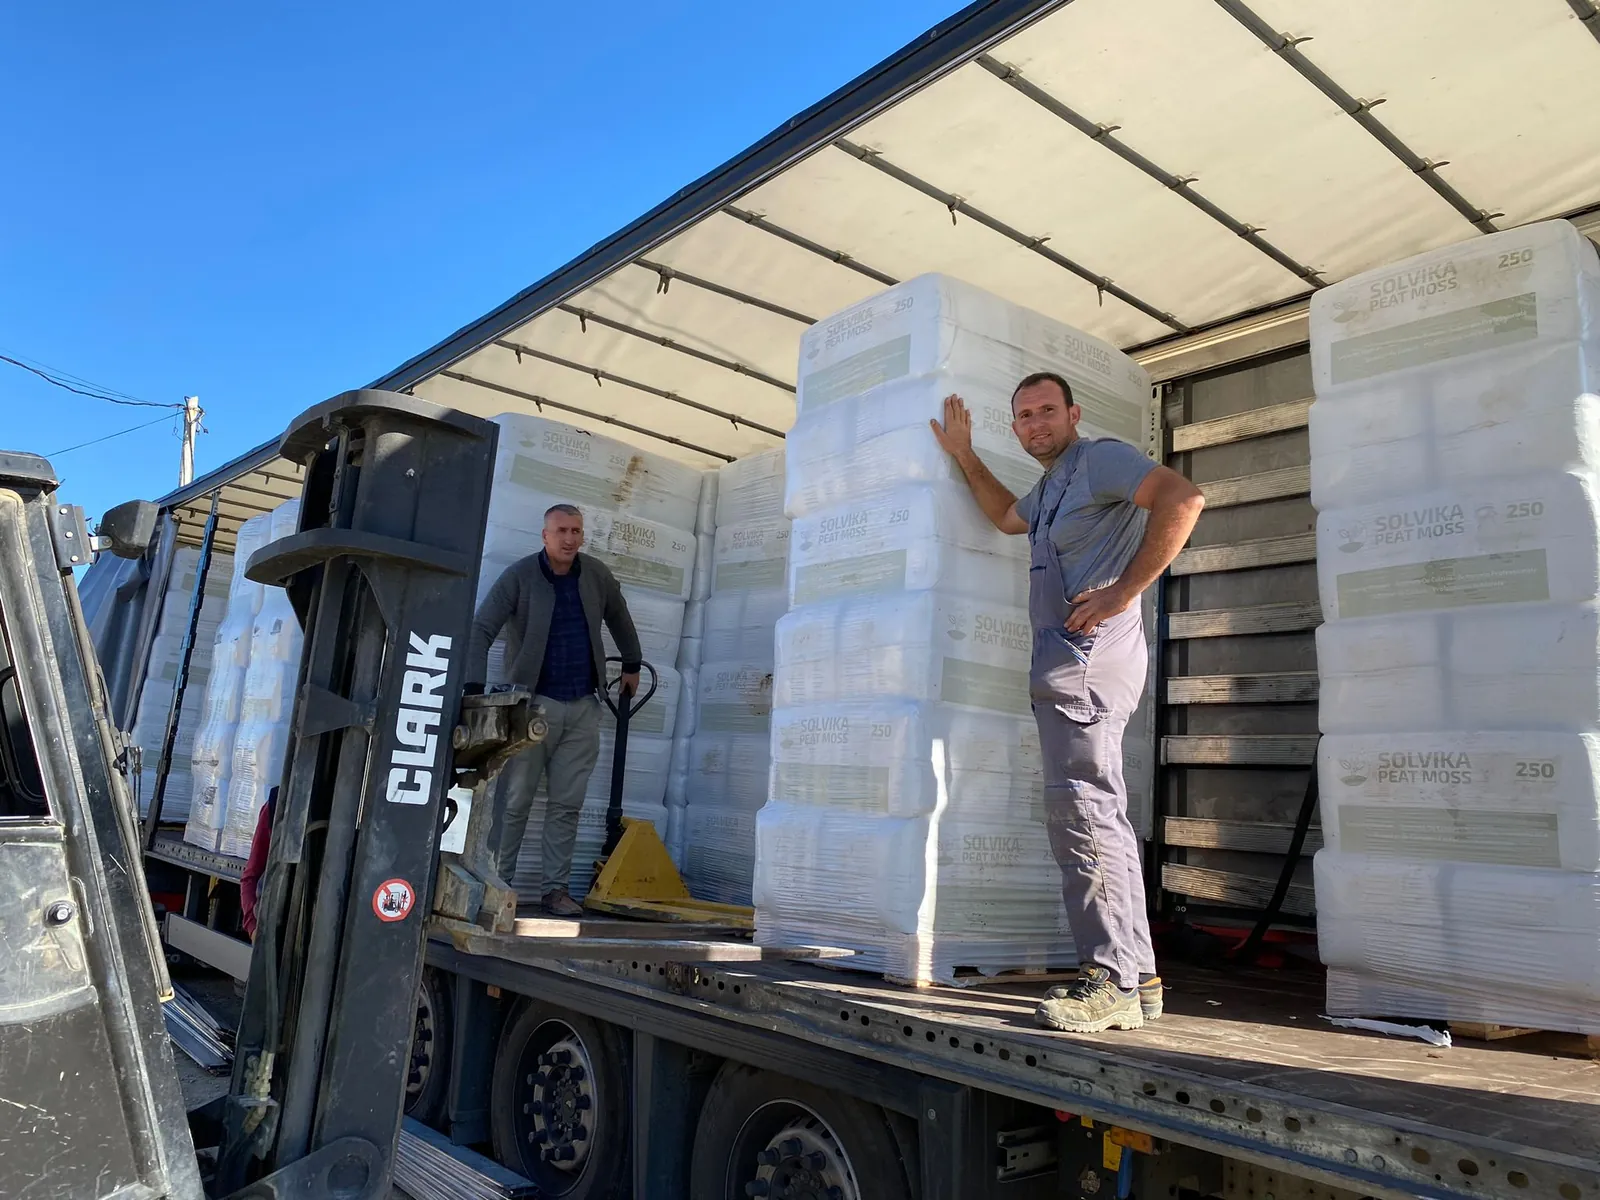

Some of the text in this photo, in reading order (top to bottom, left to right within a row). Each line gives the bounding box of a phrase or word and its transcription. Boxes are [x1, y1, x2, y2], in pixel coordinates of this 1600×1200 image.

[1498, 248, 1534, 269] 250
[1370, 261, 1458, 299] SOLVIKA
[1369, 278, 1458, 312] PEAT MOSS
[893, 296, 914, 313] 250
[846, 320, 872, 339] MOSS
[543, 431, 590, 454] SOLVIKA
[609, 454, 626, 467] 250
[889, 510, 910, 524] 250
[1374, 504, 1464, 533] SOLVIKA
[1506, 502, 1544, 518] 250
[613, 520, 656, 540] SOLVIKA
[820, 511, 868, 534] SOLVIKA
[776, 530, 789, 540] 250
[818, 526, 867, 545] PEAT MOSS
[1373, 522, 1464, 545] PEAT MOSS
[671, 540, 687, 552] 250
[974, 614, 1029, 638] SOLVIKA
[973, 631, 1030, 651] PEAT MOSS
[386, 631, 452, 805] CLARK
[800, 717, 849, 732] SOLVIKA
[800, 731, 848, 745] PEAT MOSS
[871, 723, 892, 738] 250
[1378, 751, 1472, 769] SOLVIKA
[1378, 770, 1472, 784] PEAT MOSS
[1515, 761, 1555, 778] 250
[963, 834, 1021, 852] SOLVIKA
[962, 851, 989, 863] PEAT
